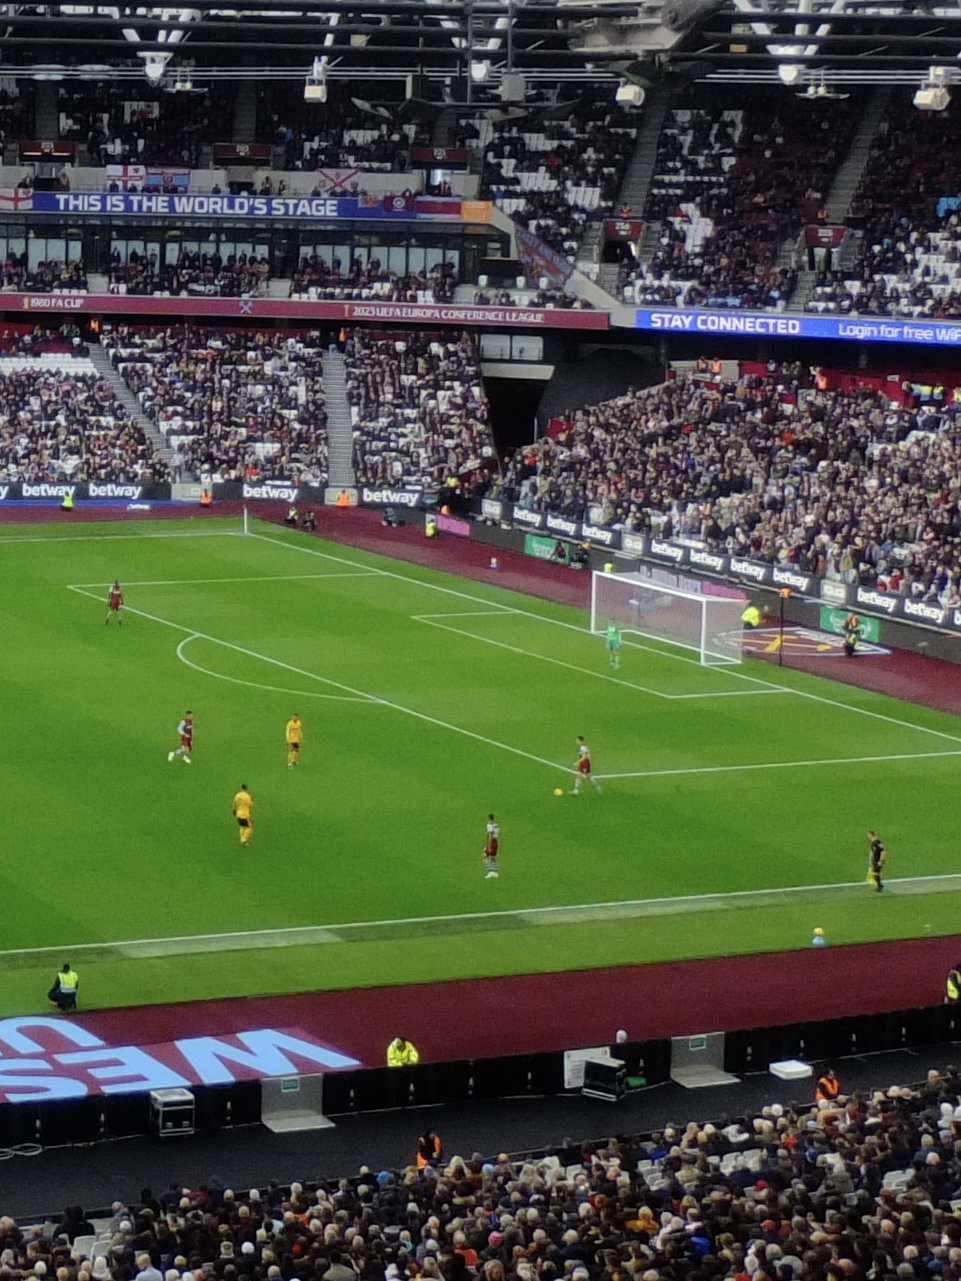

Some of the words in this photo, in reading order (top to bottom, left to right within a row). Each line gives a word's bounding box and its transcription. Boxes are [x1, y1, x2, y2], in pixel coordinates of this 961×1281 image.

[56, 194, 101, 211] THIS
[106, 195, 125, 212] IS
[129, 195, 169, 213] THE
[174, 197, 267, 215] WORLD'S
[271, 199, 338, 216] STAGE
[51, 298, 63, 307] FA
[64, 298, 84, 308] CUP
[375, 307, 401, 317] UEFA
[402, 307, 440, 318] EUROPA
[442, 309, 505, 321] CONFERENCE
[506, 313, 544, 323] LEAGUE
[651, 313, 693, 329] STAY
[696, 315, 800, 334] CONNECTED
[839, 323, 877, 339] Login
[880, 324, 902, 338] for
[903, 325, 933, 340] free
[22, 483, 76, 498] betway
[89, 483, 141, 500] betway
[243, 483, 298, 502] betway
[363, 487, 419, 507] betway
[547, 514, 576, 536] betway
[582, 523, 612, 545] betway
[651, 539, 684, 562] betway
[690, 549, 723, 571] betway
[730, 558, 766, 581] betway
[773, 567, 809, 591] betway
[857, 587, 897, 612] betway
[904, 598, 945, 623] betway
